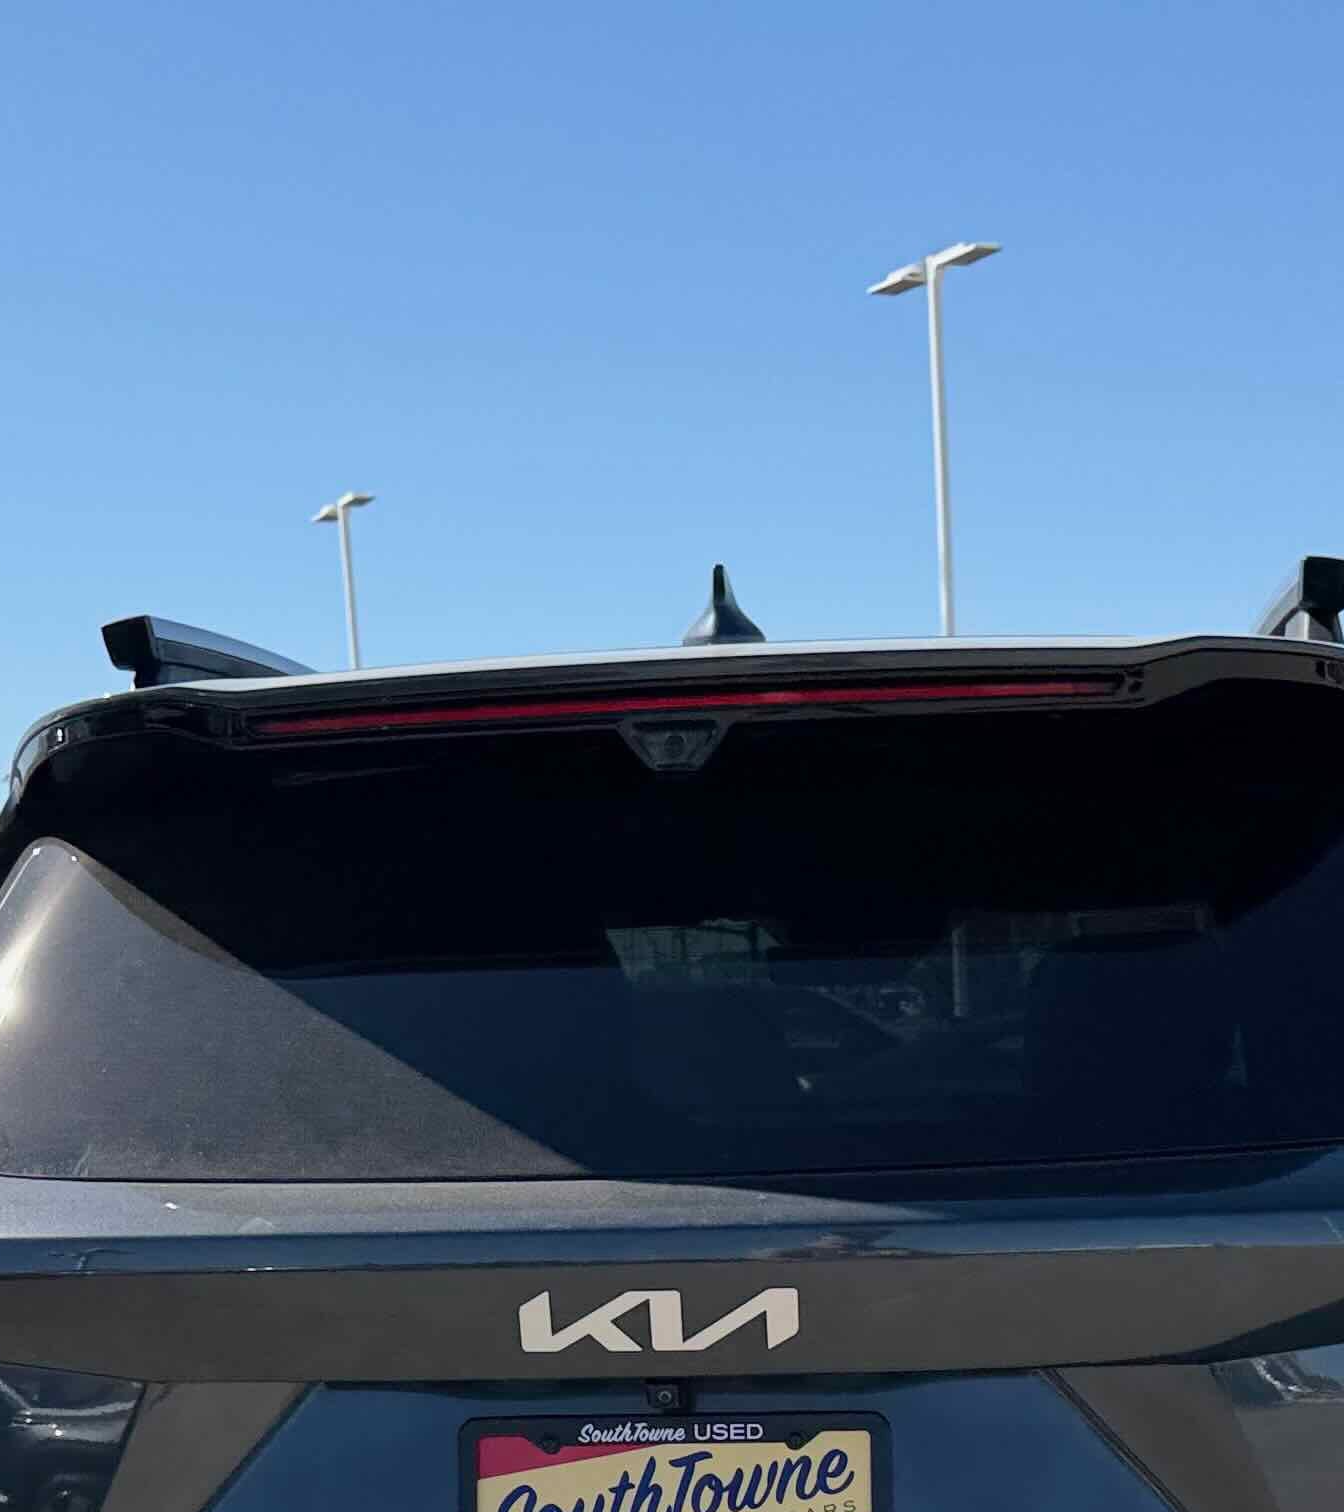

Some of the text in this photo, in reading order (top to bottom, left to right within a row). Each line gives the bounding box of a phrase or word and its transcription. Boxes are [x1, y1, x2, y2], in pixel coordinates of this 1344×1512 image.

[518, 1287, 800, 1352] KIA
[577, 1421, 764, 1444] SouthTowne USED
